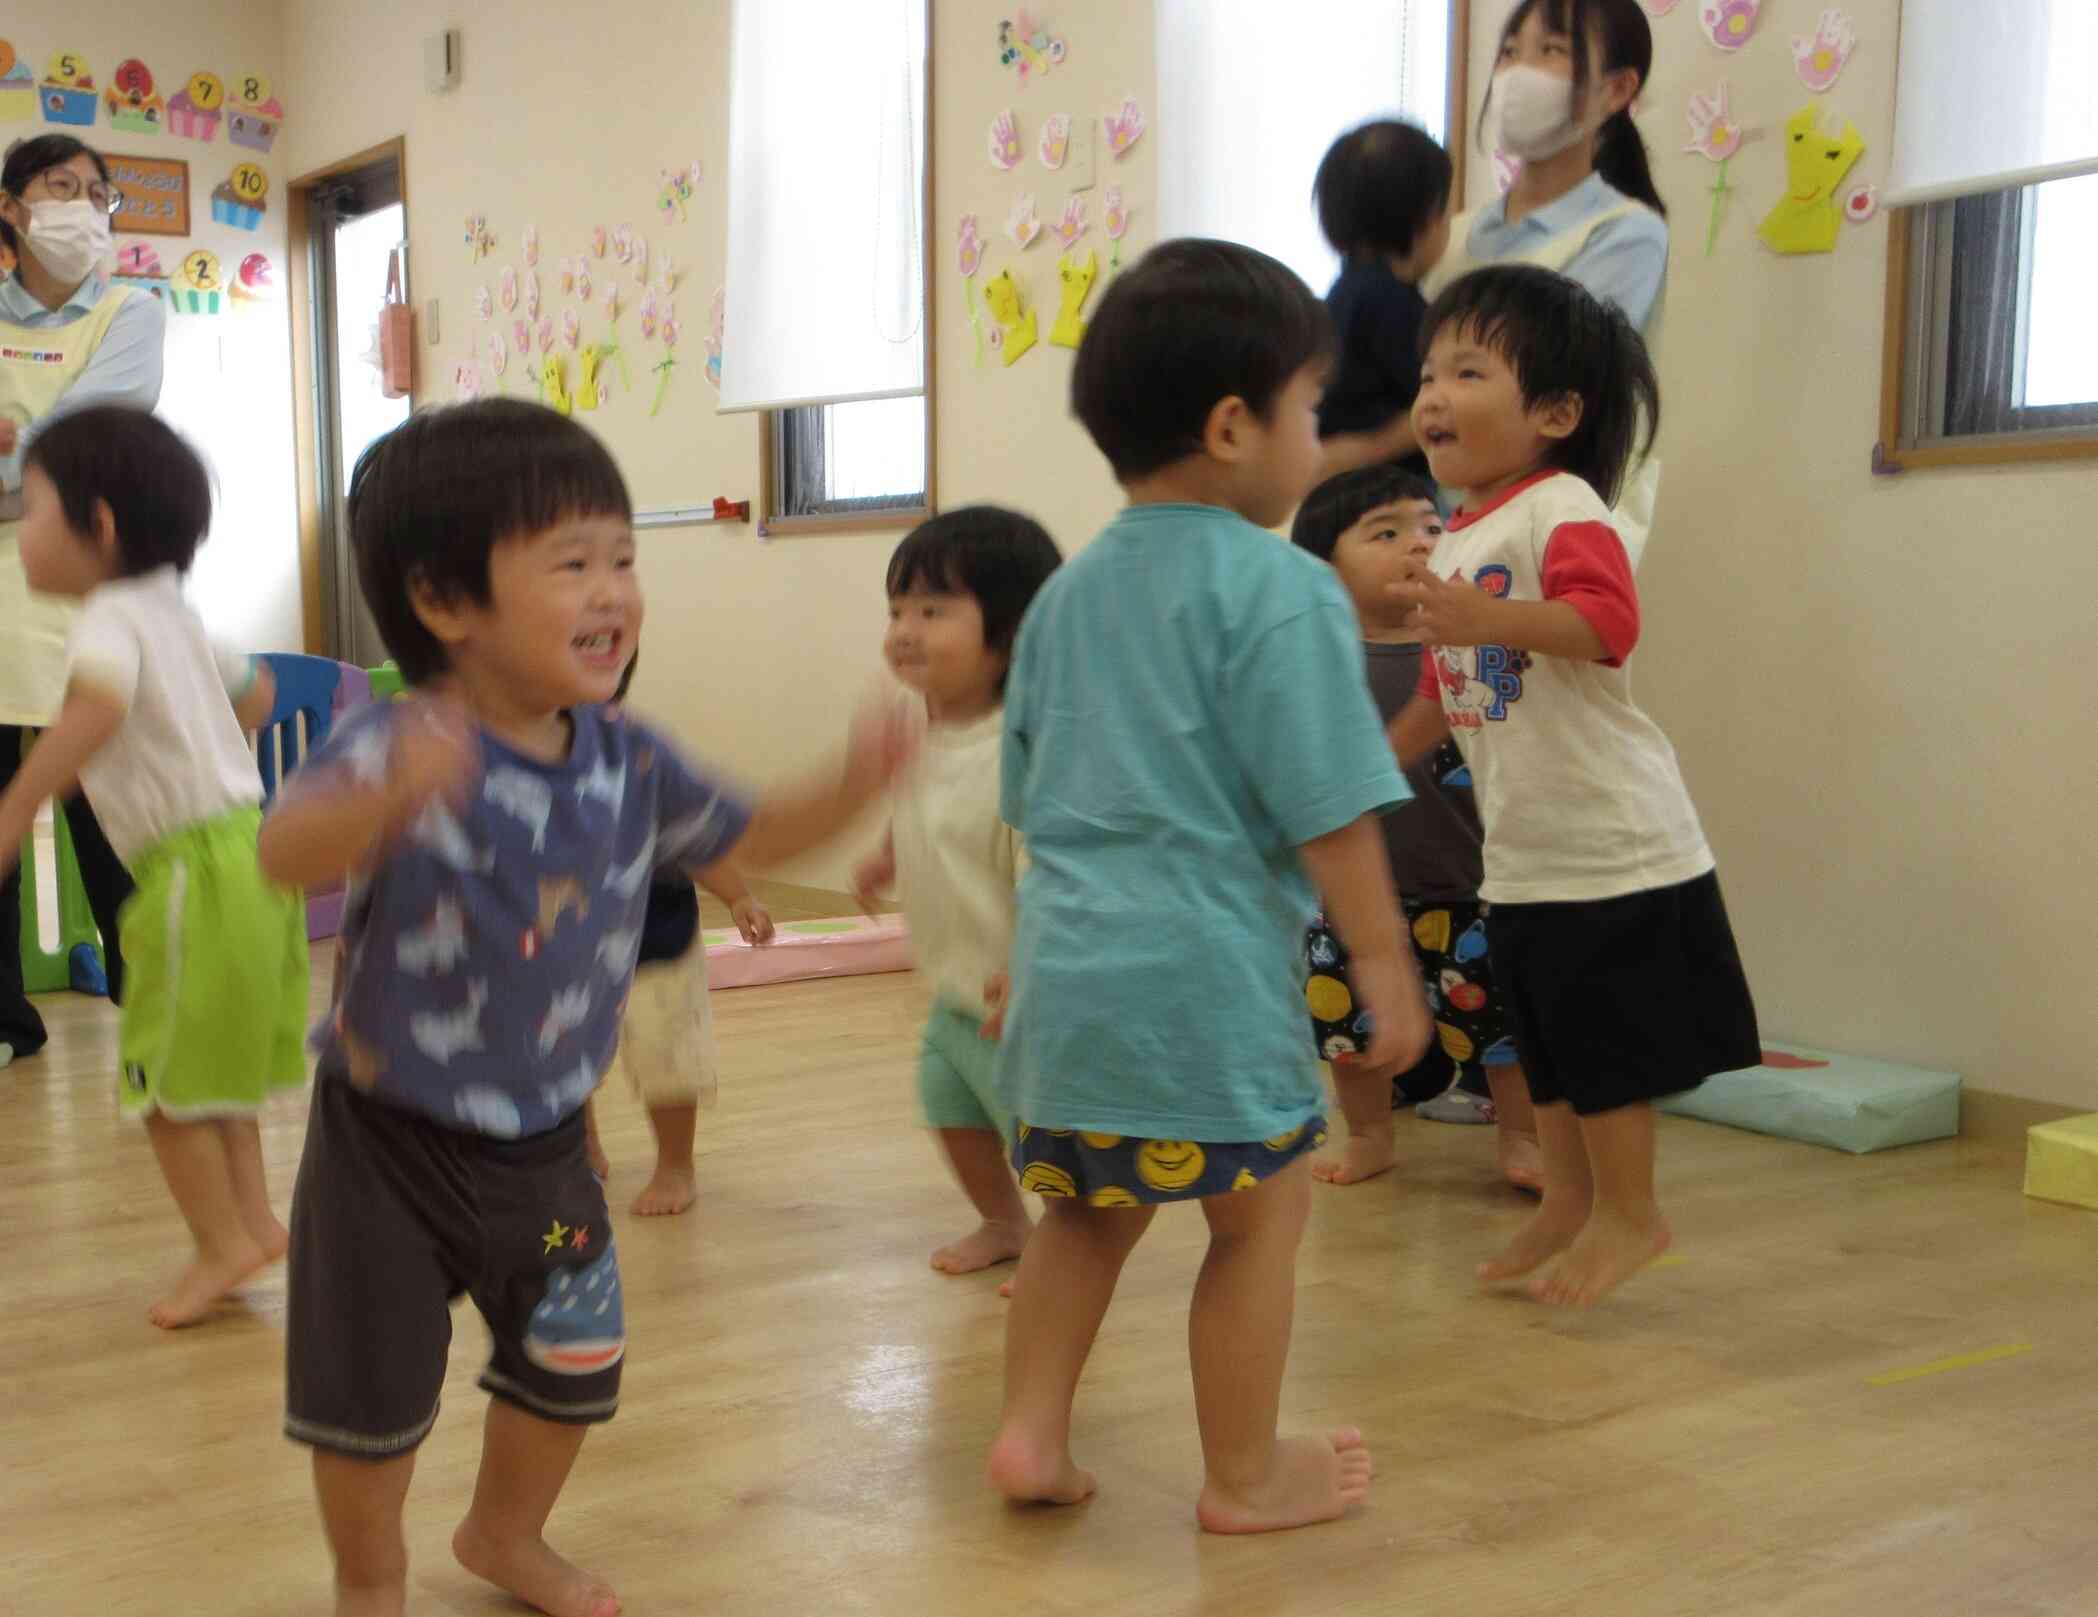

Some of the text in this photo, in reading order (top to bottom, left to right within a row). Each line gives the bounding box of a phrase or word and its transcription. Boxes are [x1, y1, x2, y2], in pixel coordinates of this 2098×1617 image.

[60, 55, 77, 78] 5
[198, 81, 213, 102] 7
[243, 78, 260, 102] 8
[238, 171, 262, 194] 10
[131, 246, 142, 265] 1
[195, 258, 211, 280] 2
